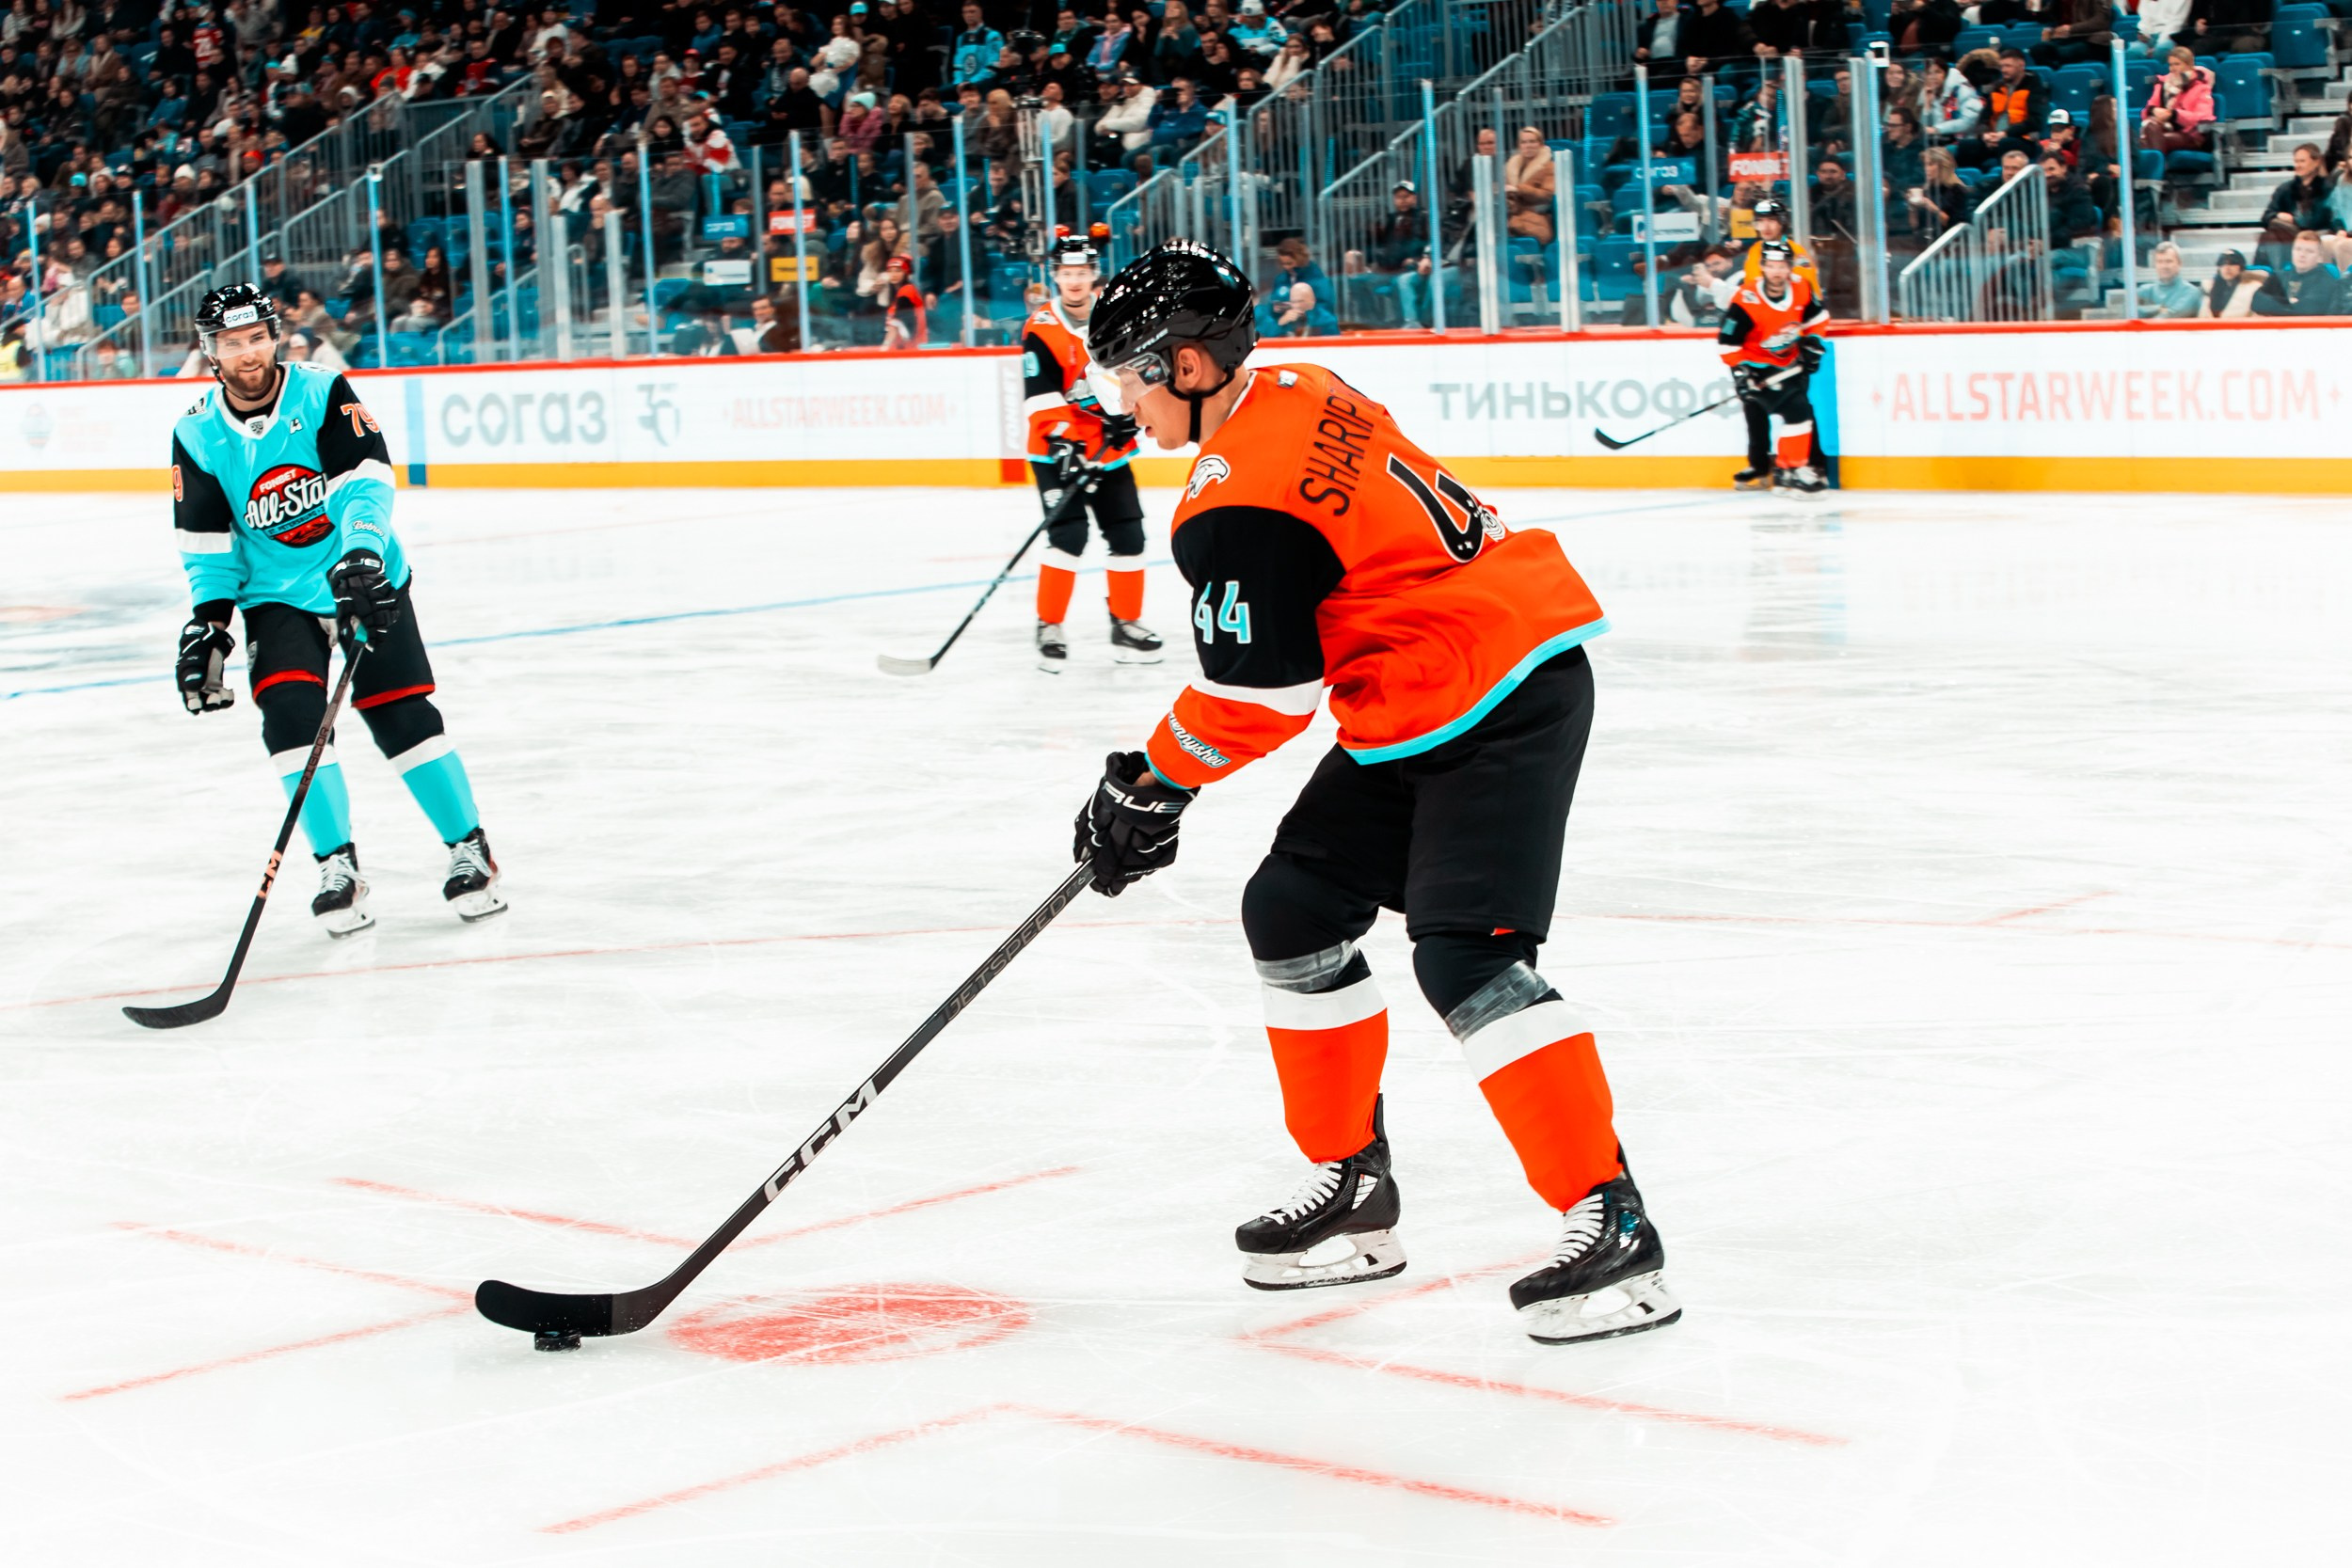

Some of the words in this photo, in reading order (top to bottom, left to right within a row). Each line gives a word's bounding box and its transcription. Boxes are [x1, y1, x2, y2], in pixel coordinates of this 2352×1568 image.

[1134, 328, 1168, 354] TRUE
[340, 403, 381, 438] 79
[441, 389, 608, 448] согаз
[1891, 370, 2321, 422] ALLSTARWEEK.COM
[259, 467, 297, 494] FONBET
[1194, 579, 1252, 645] 44
[946, 895, 1068, 1022] JETSPEED
[763, 1079, 879, 1203] CCM
